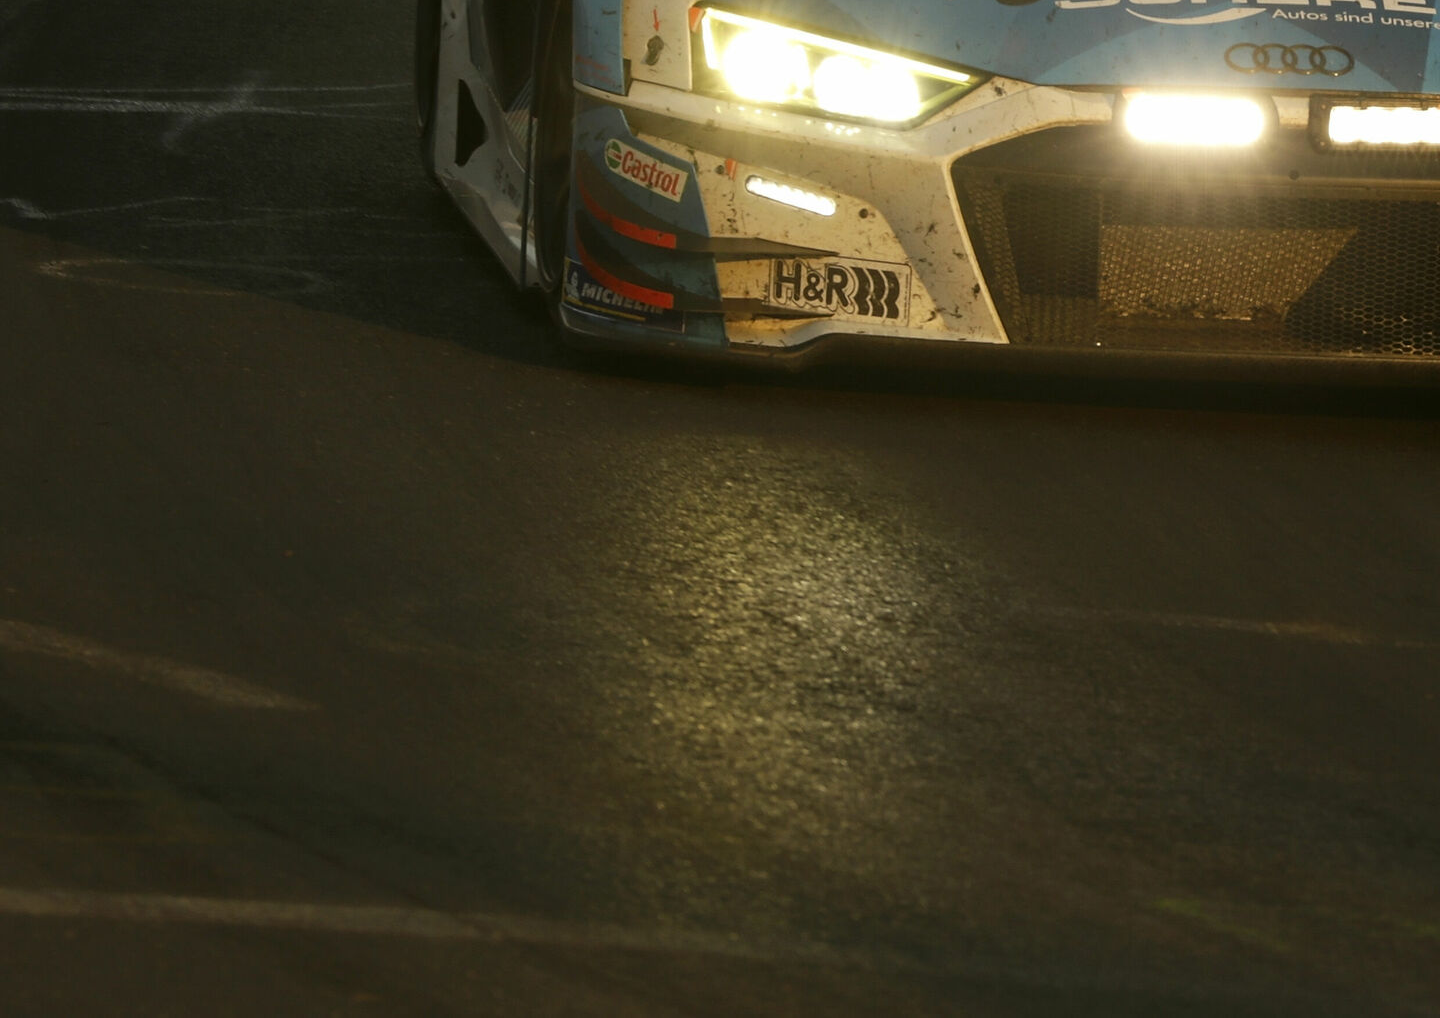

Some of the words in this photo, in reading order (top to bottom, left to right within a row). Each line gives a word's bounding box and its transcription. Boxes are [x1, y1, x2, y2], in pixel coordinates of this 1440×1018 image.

[1272, 7, 1328, 23] Autos
[1334, 11, 1374, 24] sind
[621, 150, 682, 197] Castrol
[774, 259, 850, 309] H&R
